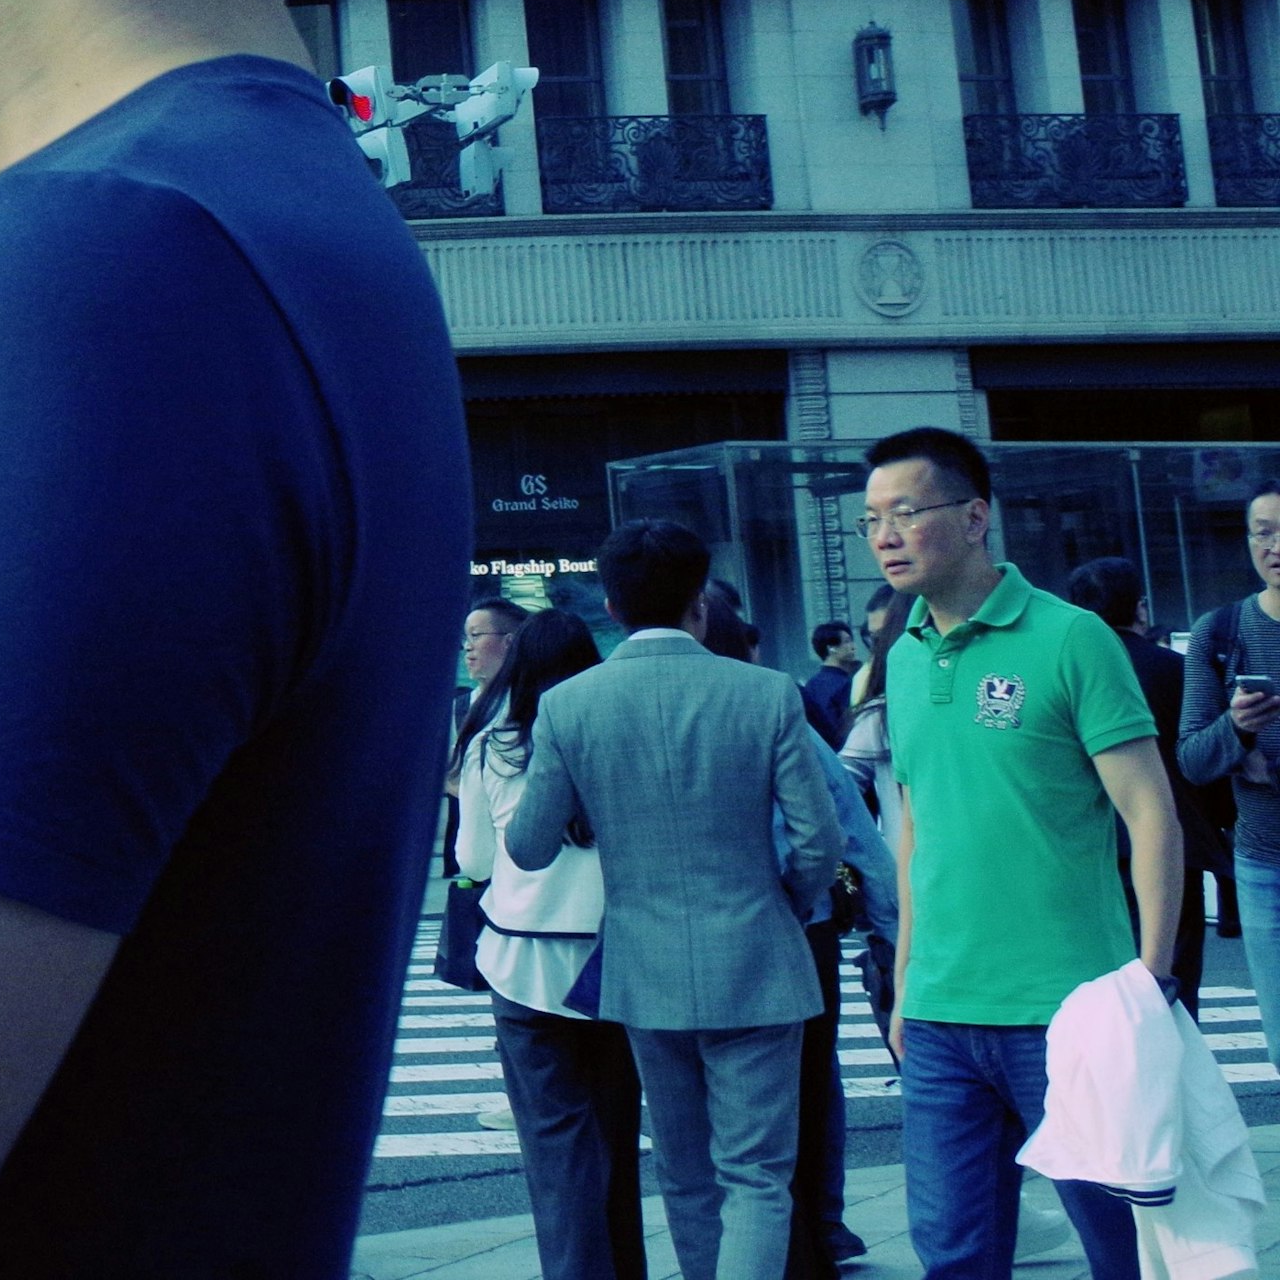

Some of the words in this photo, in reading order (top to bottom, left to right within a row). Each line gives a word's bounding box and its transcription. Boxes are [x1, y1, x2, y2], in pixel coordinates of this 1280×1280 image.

[520, 474, 548, 496] GS
[492, 497, 537, 512] Grand
[541, 496, 580, 511] Seiko
[490, 559, 556, 577] Flagship
